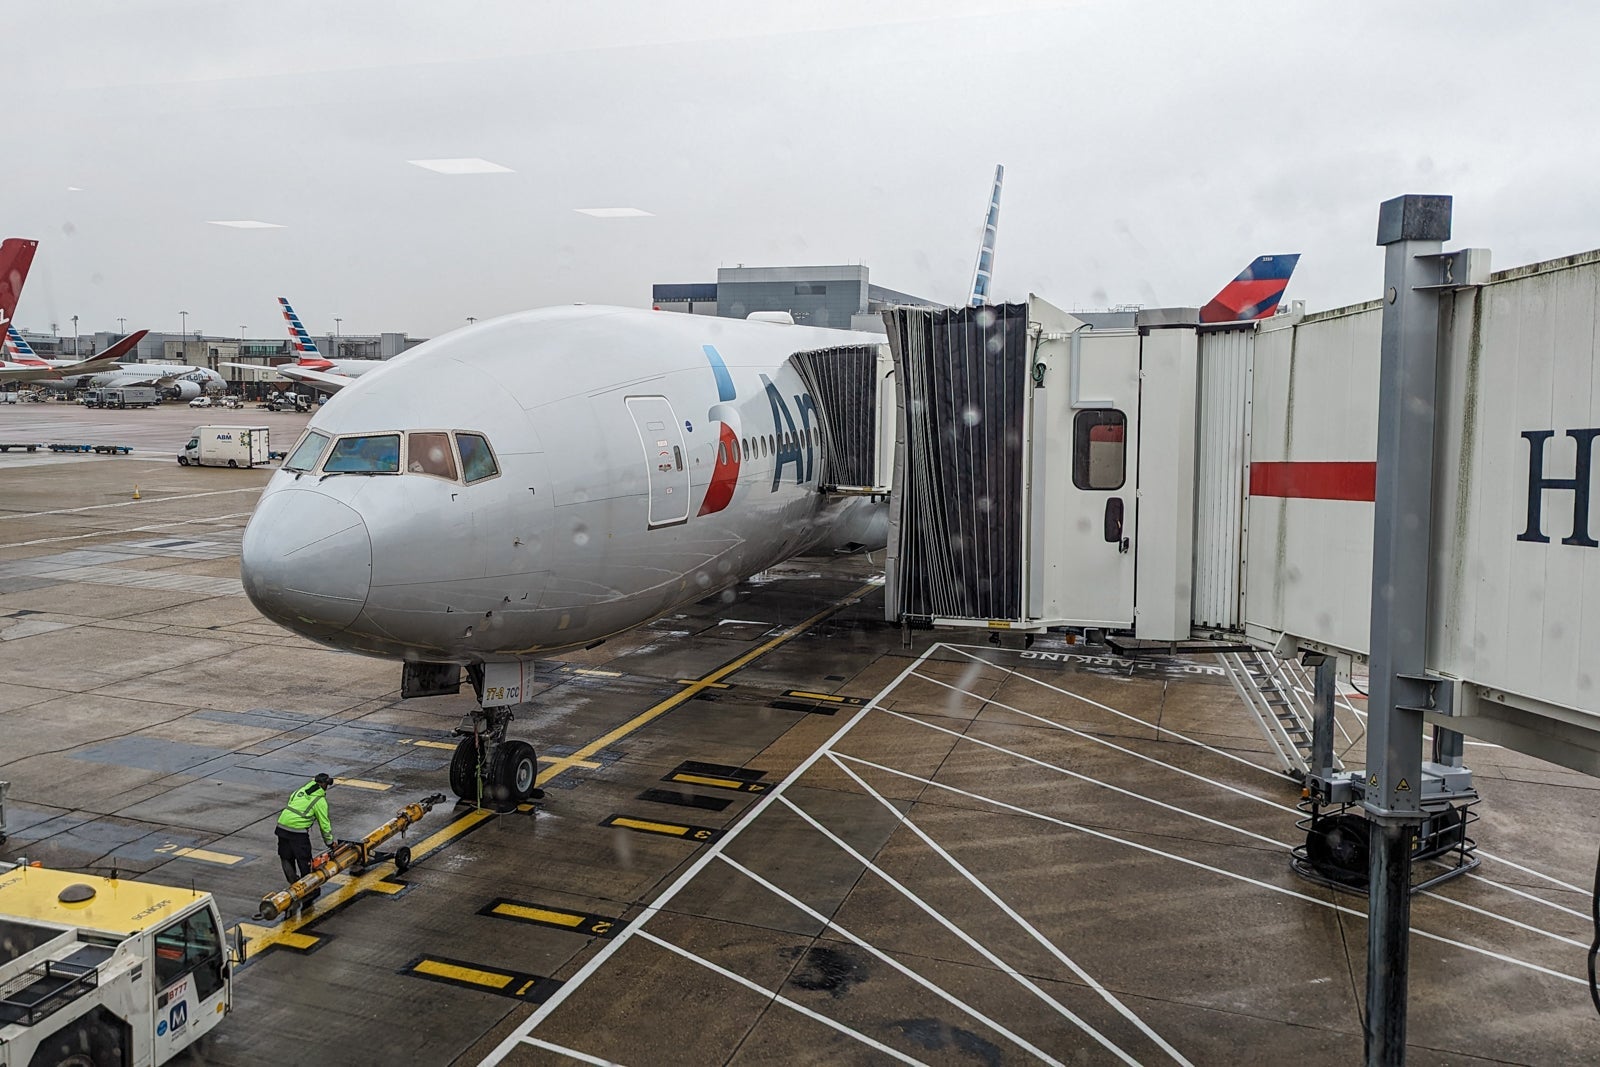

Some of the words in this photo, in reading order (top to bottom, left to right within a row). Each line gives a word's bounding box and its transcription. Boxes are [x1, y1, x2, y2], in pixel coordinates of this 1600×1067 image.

[1516, 428, 1600, 548] H
[1019, 651, 1157, 671] PARKING
[1184, 665, 1225, 676] NO
[748, 784, 765, 792] 4
[694, 830, 712, 839] 3
[153, 841, 179, 853] 2
[591, 920, 615, 934] 2
[169, 982, 188, 1000] B777
[515, 980, 535, 995] 1
[171, 1005, 186, 1030] M
